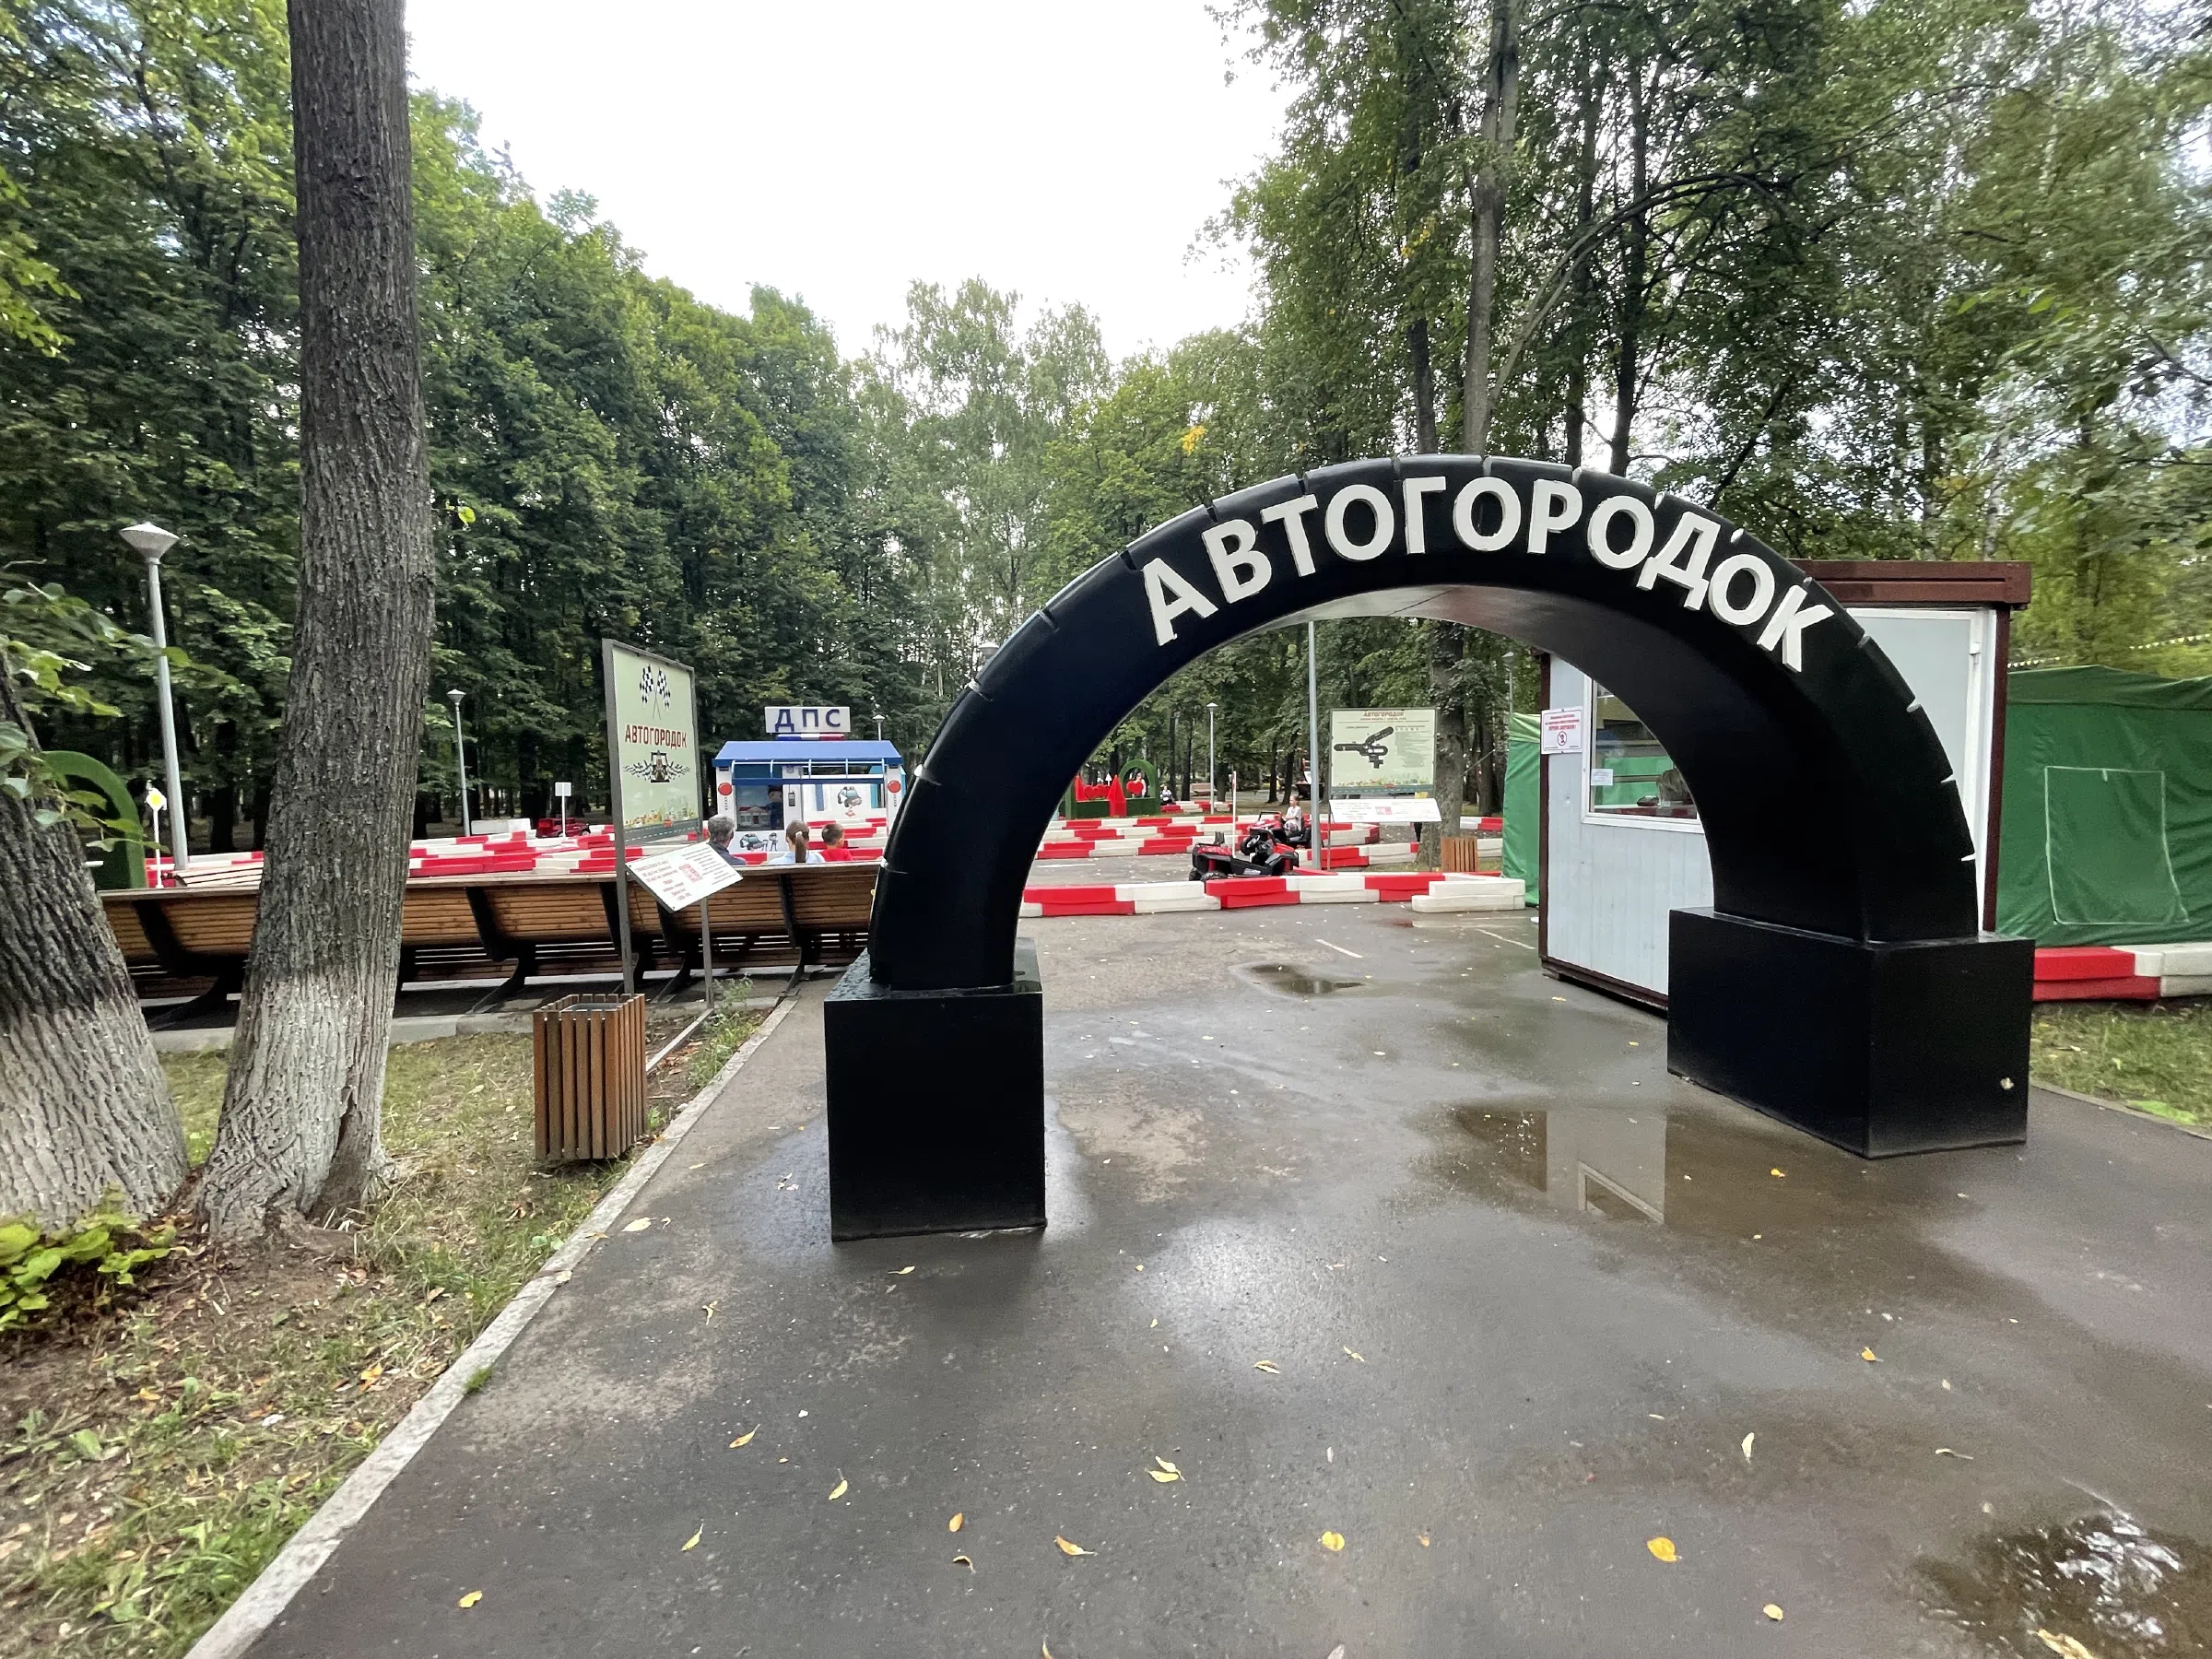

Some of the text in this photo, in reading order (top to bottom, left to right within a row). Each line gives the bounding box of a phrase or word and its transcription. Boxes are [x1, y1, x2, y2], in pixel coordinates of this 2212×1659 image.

[1143, 476, 1834, 674] АВТОГОРОДОК
[775, 709, 841, 733] ДПС
[624, 724, 688, 749] АВТОГОРОДОК
